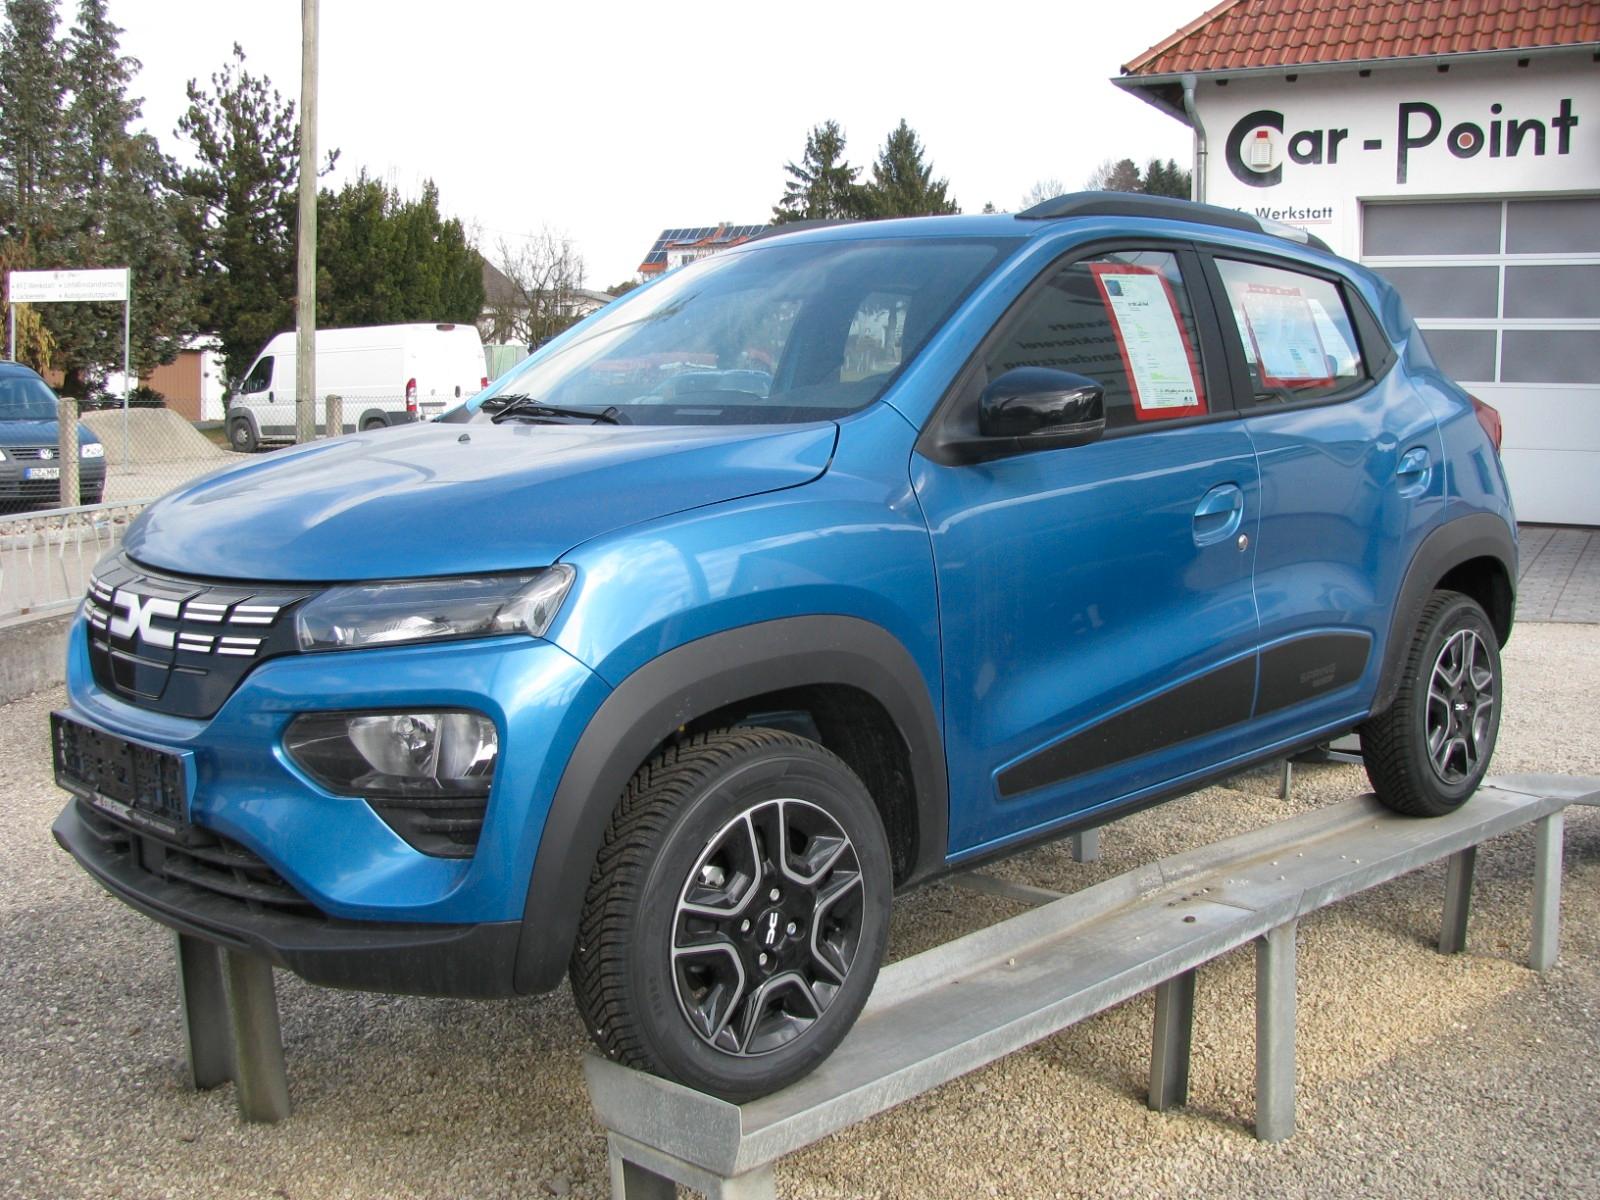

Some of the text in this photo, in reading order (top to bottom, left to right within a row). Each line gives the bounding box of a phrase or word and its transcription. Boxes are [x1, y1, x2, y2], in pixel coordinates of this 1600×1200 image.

[1225, 109, 1348, 188] Car
[1396, 98, 1578, 185] Point
[1255, 206, 1332, 220] Werkstatt
